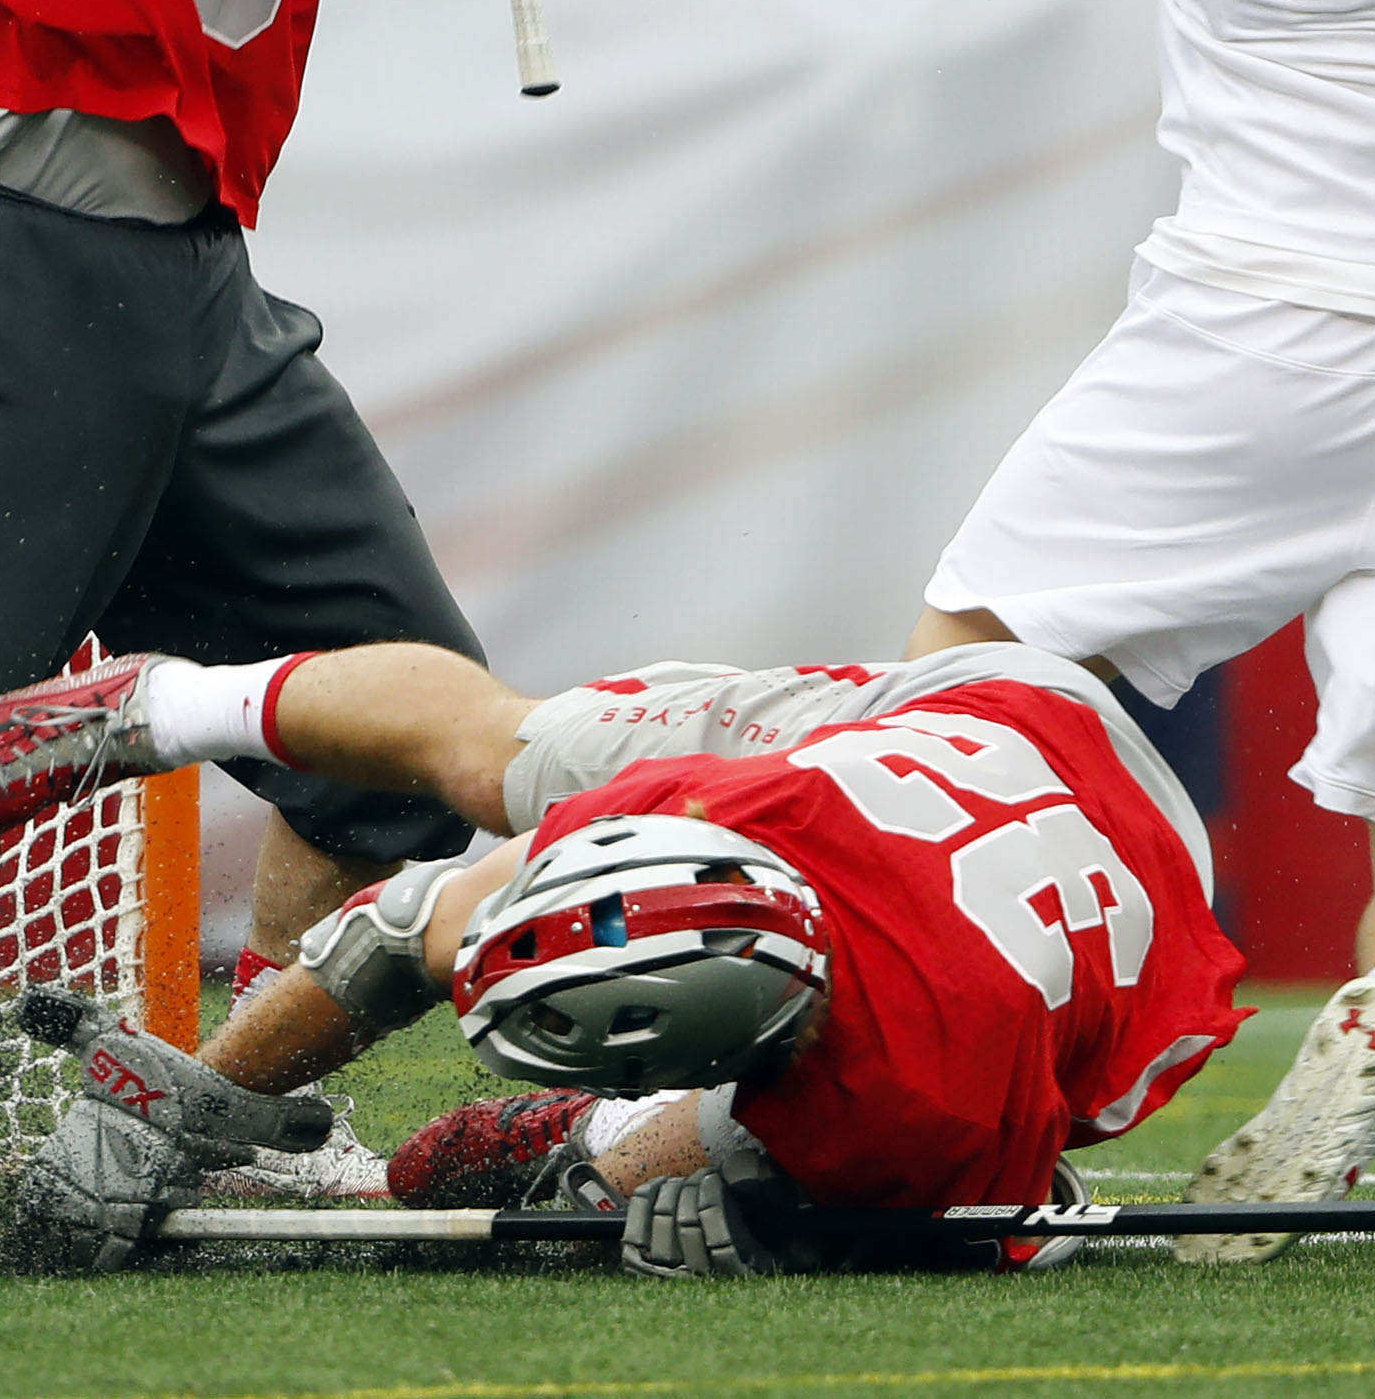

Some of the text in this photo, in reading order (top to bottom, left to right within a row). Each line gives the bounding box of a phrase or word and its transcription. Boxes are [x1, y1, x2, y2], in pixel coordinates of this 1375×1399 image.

[788, 709, 1155, 1012] 32
[88, 1048, 168, 1118] STX
[945, 1204, 1122, 1225] STX HAMMER
